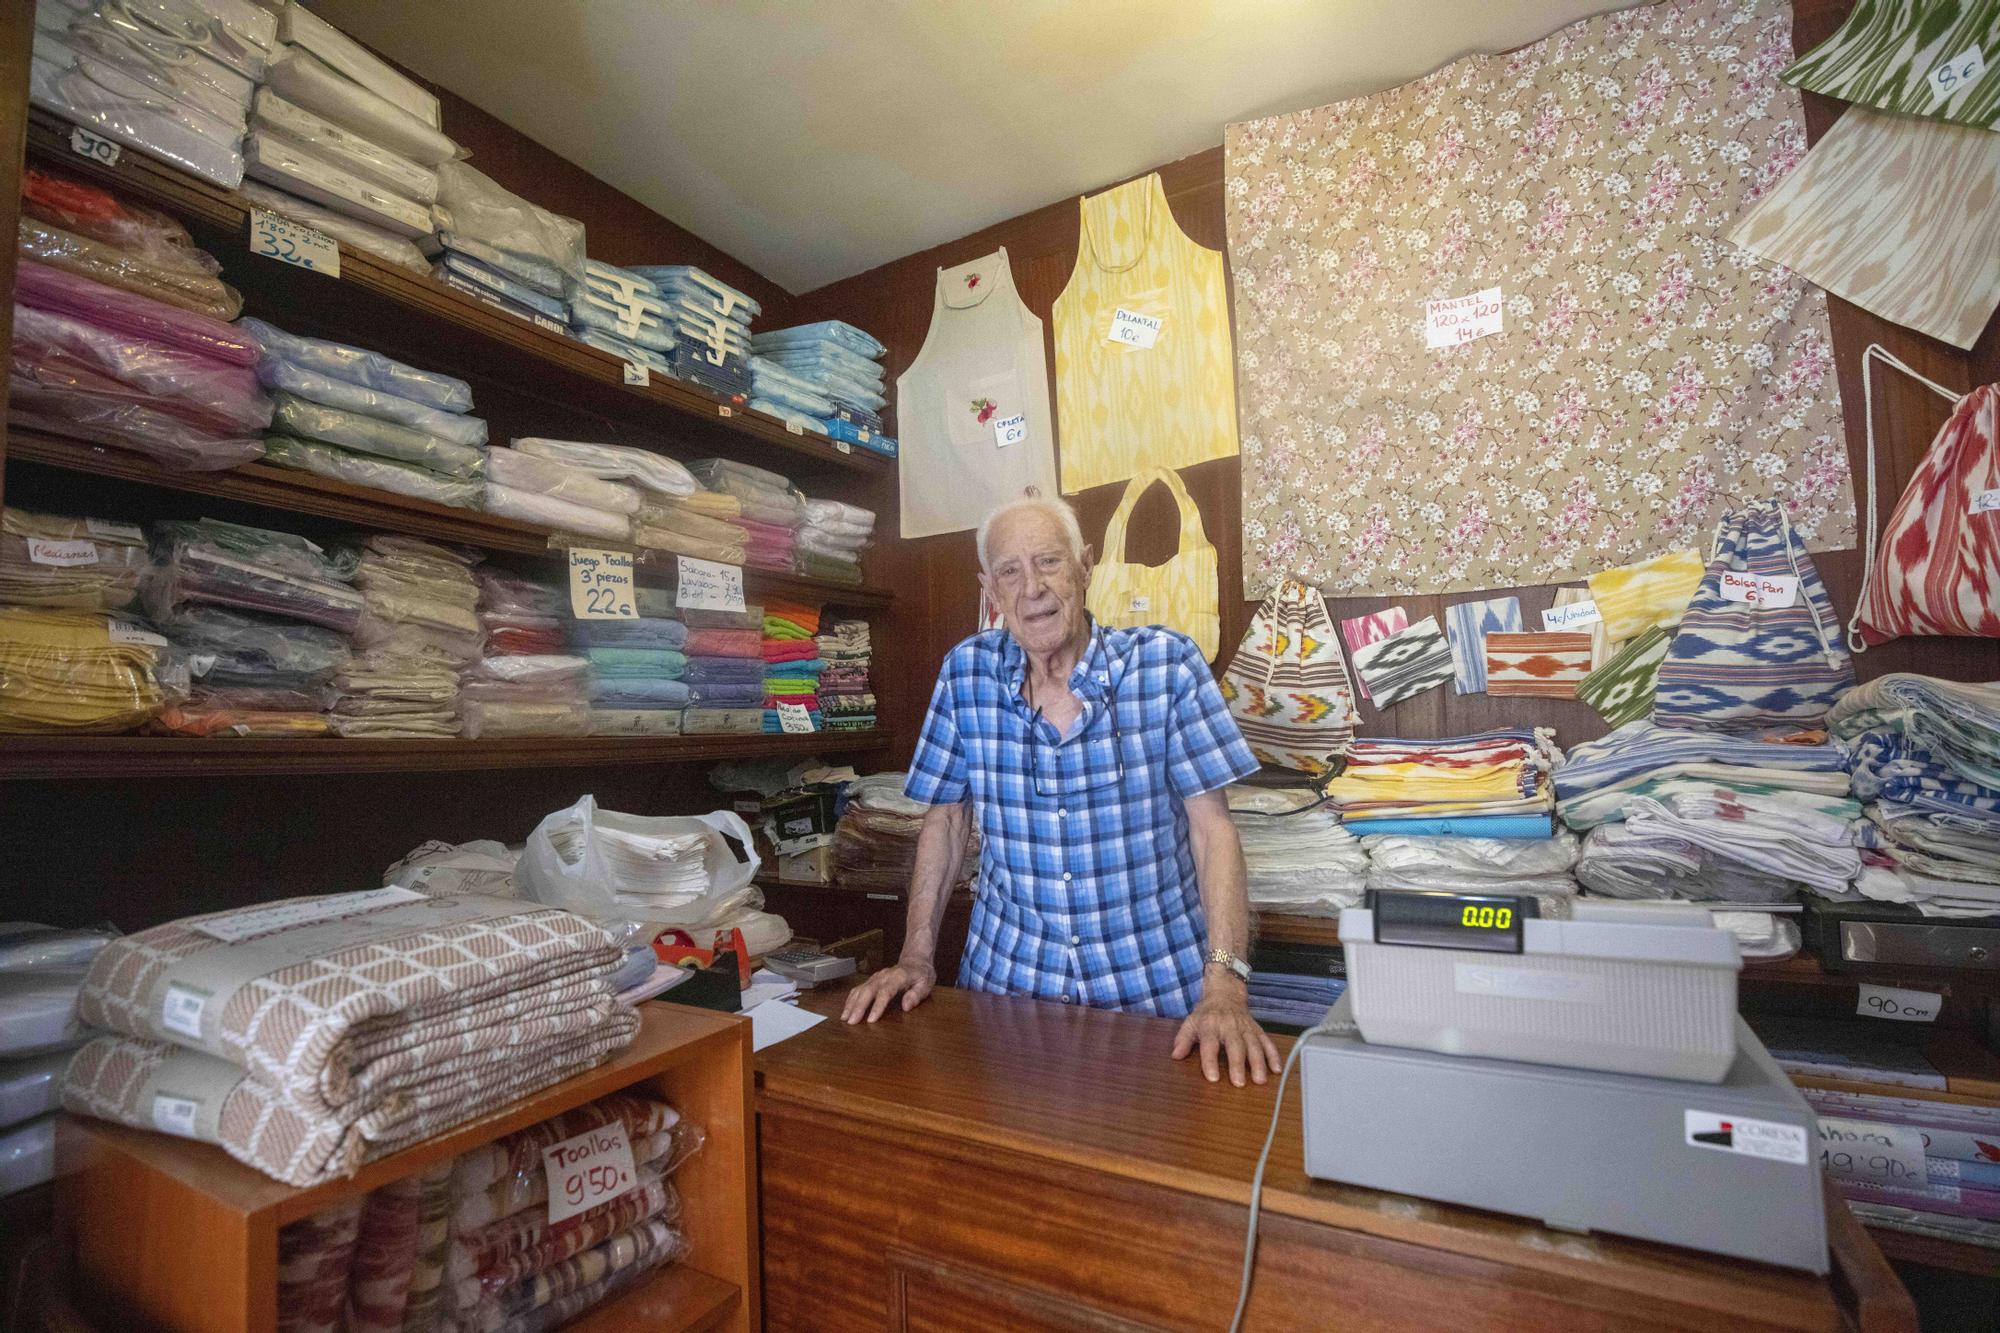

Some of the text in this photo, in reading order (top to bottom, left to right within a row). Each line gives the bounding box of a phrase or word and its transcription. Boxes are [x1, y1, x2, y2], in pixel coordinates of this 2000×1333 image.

[1430, 296, 1483, 315] MANTEL
[1116, 310, 1158, 330] DELANTAL
[1432, 314, 1458, 328] 120
[1473, 303, 1499, 319] 120
[997, 416, 1025, 428] OFERTA
[571, 552, 600, 571] Juego
[580, 570, 592, 583] 3
[1725, 575, 1784, 594] Bolsa Pan
[1462, 905, 1512, 929] 0.00
[1868, 996, 1898, 1013] 90
[549, 1133, 622, 1168] Toallas
